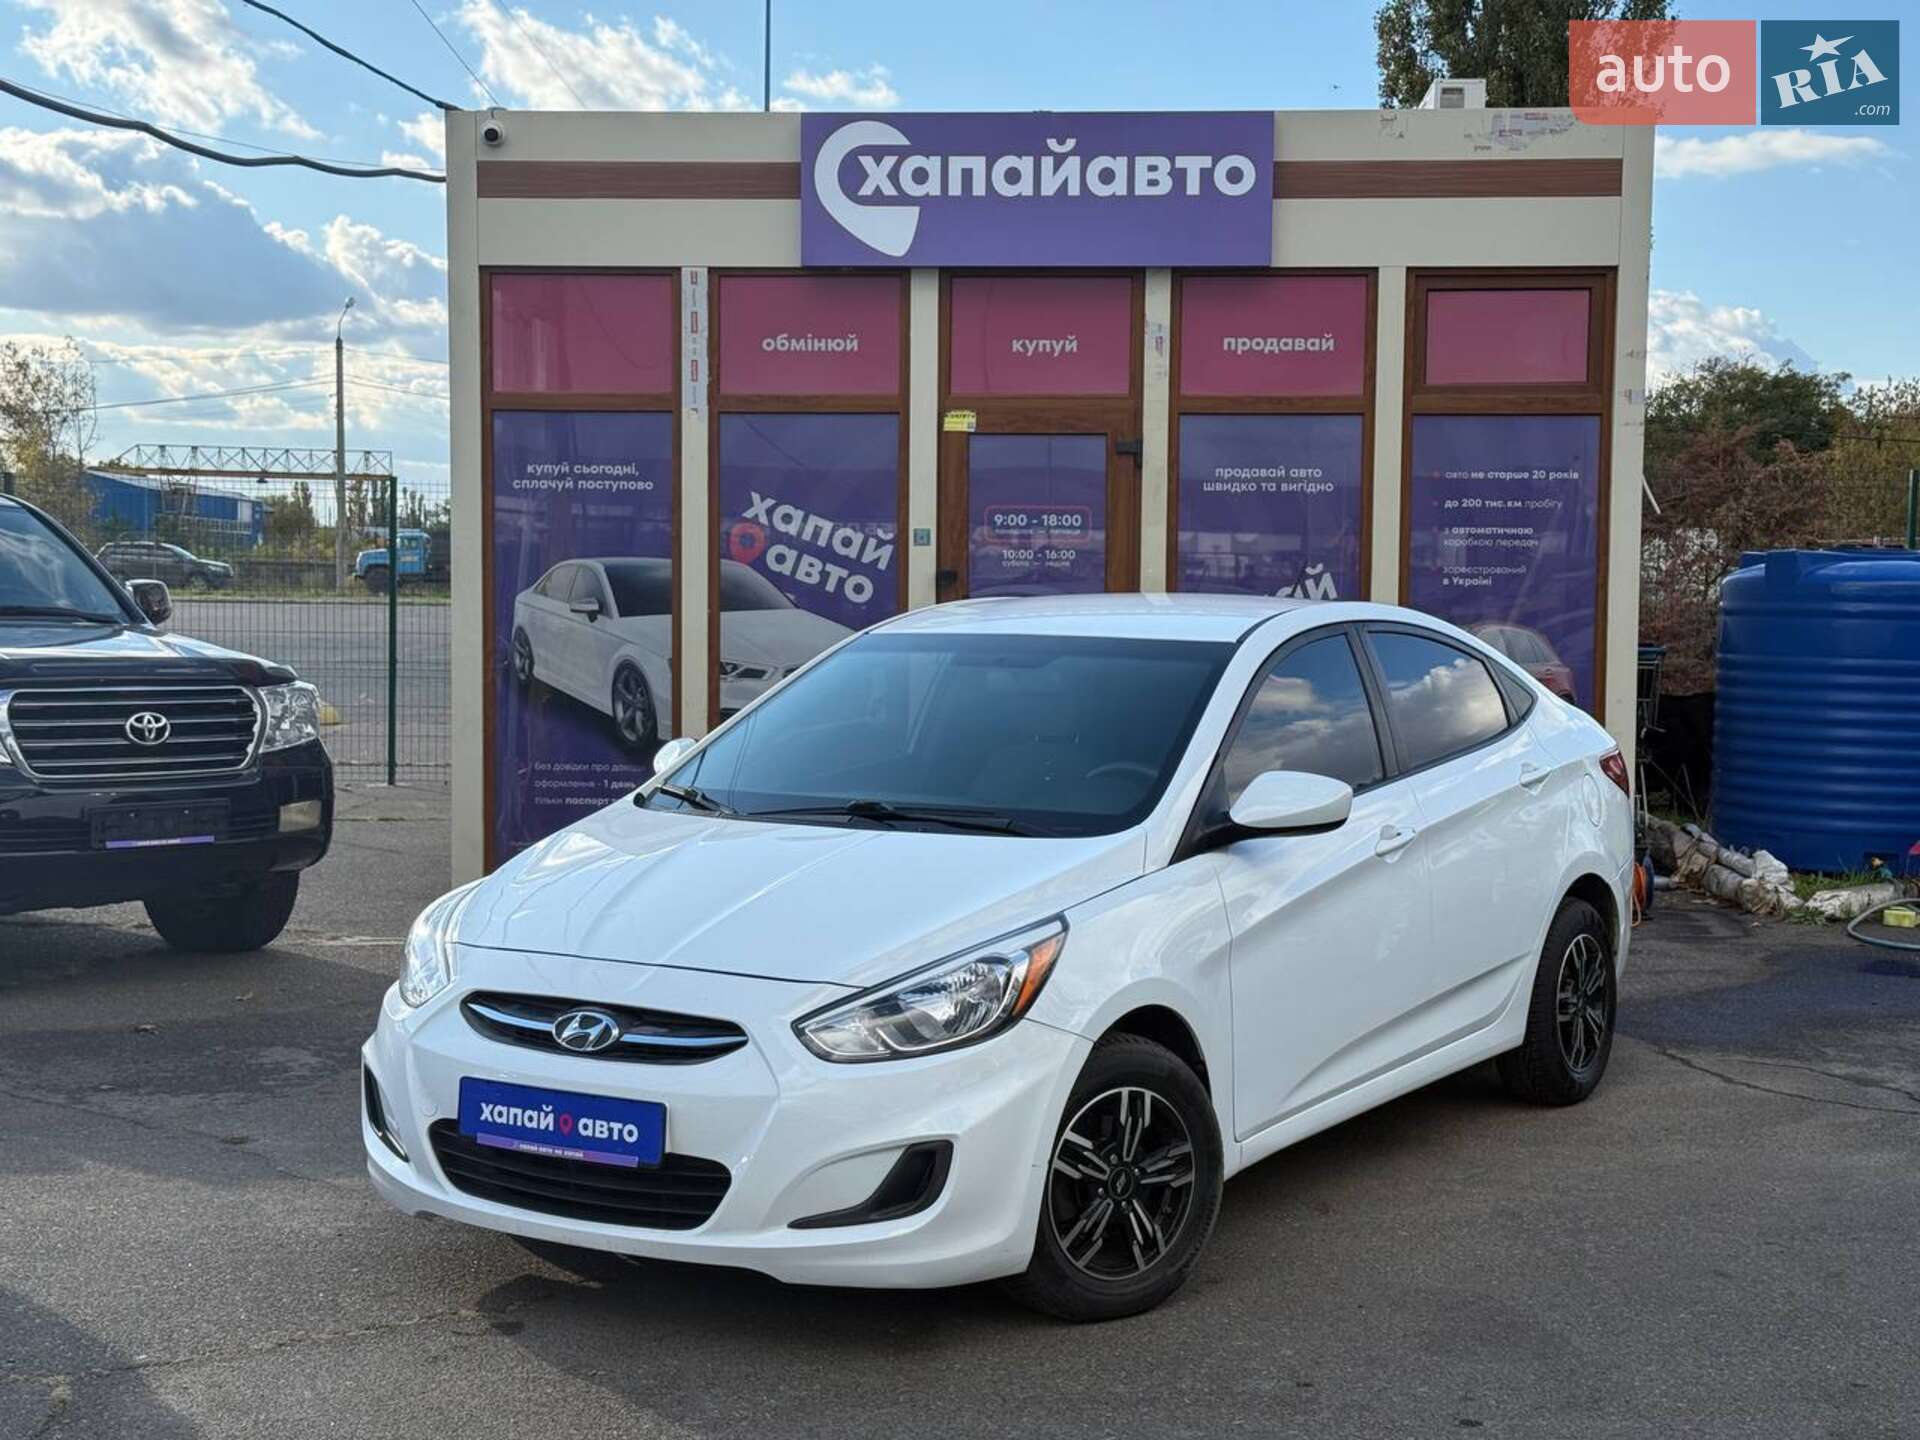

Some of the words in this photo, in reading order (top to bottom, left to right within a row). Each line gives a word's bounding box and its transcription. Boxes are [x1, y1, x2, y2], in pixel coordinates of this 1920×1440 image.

[857, 138, 1257, 197] хапайавто
[762, 333, 858, 351] обмінюй
[1012, 335, 1078, 357] купуй
[1223, 333, 1334, 355] продавай
[527, 461, 569, 476] купуй
[574, 462, 639, 476] сьогодні,
[1215, 466, 1285, 479] продавай
[1290, 467, 1322, 478] авто
[1445, 471, 1469, 479] авто
[1471, 471, 1484, 479] не
[1487, 471, 1529, 480] старше
[1532, 470, 1546, 479] 20
[1549, 469, 1579, 480] років
[513, 477, 573, 492] сплачуй
[578, 480, 654, 492] поступово
[1203, 482, 1257, 492] швидко
[1261, 482, 1276, 491] та
[1281, 480, 1334, 493] вигідно
[1444, 501, 1459, 509] до
[1461, 499, 1482, 507] 200
[1524, 499, 1562, 510] пробігу
[994, 513, 1028, 527] 9:00
[1041, 513, 1082, 527] 18:00
[742, 491, 894, 571] хапай
[1451, 527, 1534, 535] автоматичною
[1002, 550, 1034, 560] 10:00
[1045, 550, 1076, 560] 16:00
[766, 544, 874, 603] авто
[480, 1102, 554, 1132] хапай
[578, 1117, 639, 1143] авто
